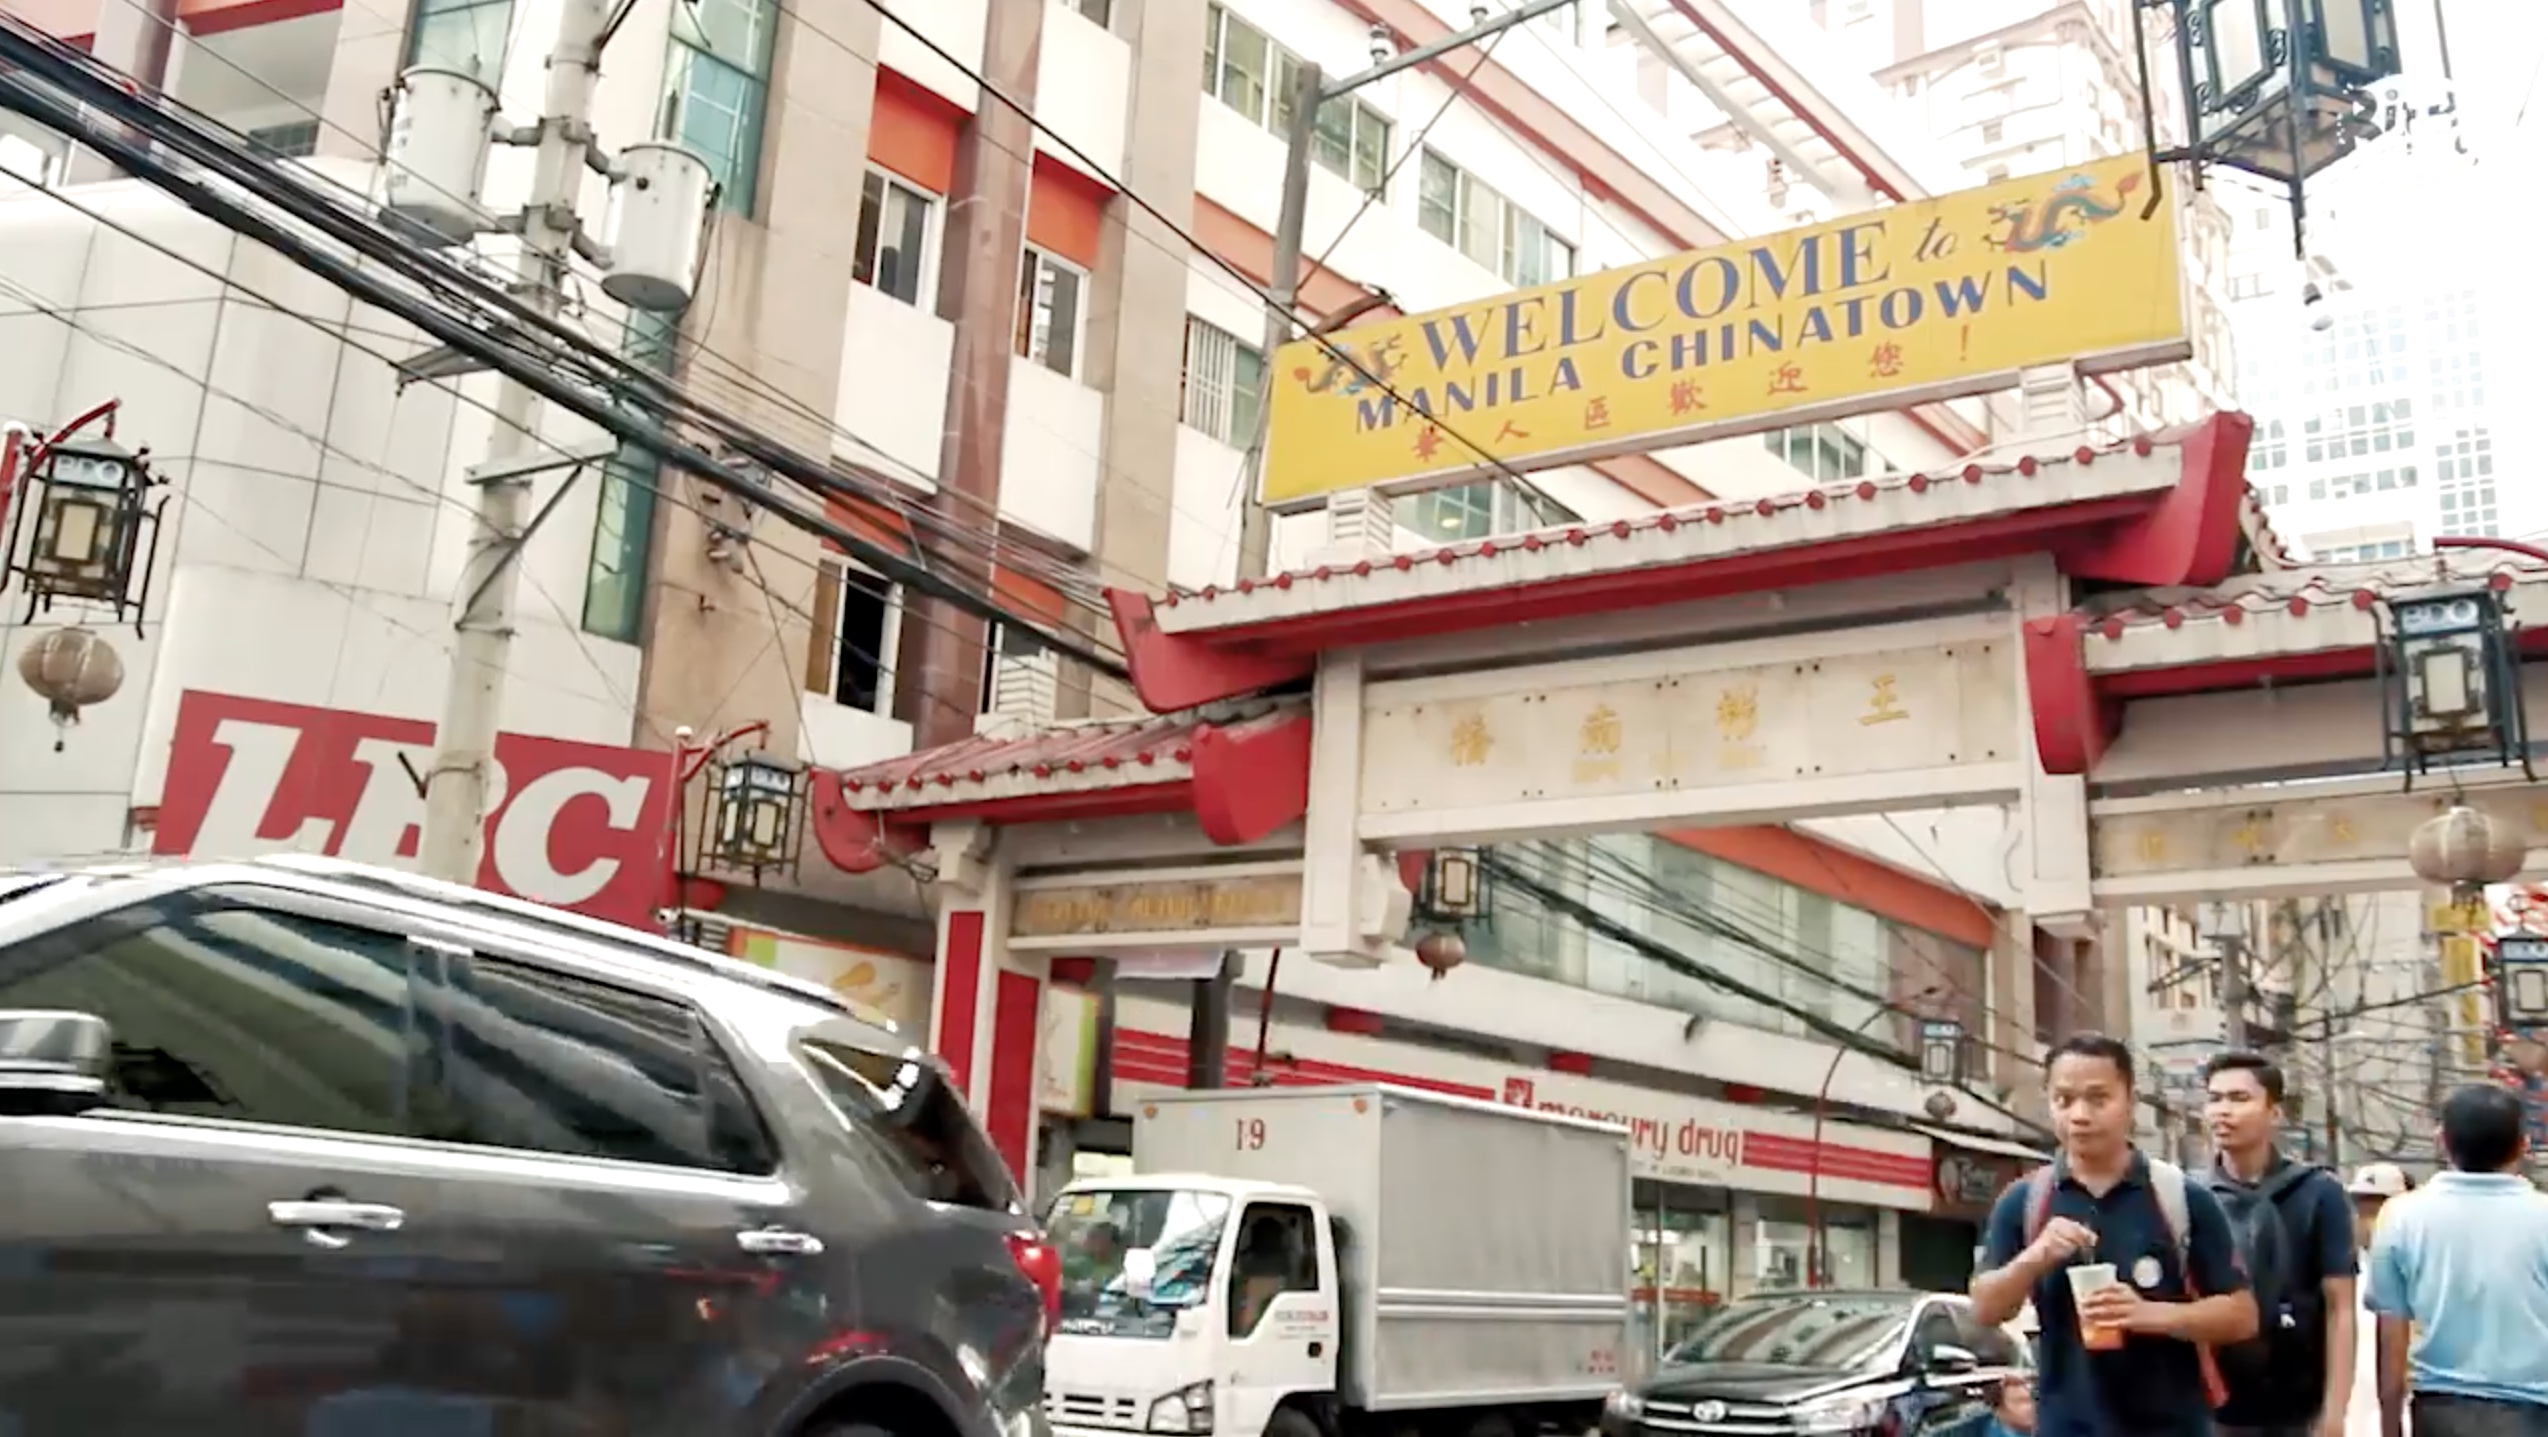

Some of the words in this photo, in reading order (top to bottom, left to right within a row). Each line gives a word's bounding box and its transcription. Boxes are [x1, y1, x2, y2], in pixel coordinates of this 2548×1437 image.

[1419, 220, 1890, 373] WELCOME
[1912, 216, 1959, 264] to
[1357, 356, 1581, 434] MANILA
[1622, 260, 2047, 379] CHINATOWN
[1237, 1118, 1265, 1151] 19
[1678, 1118, 1739, 1168] drug
